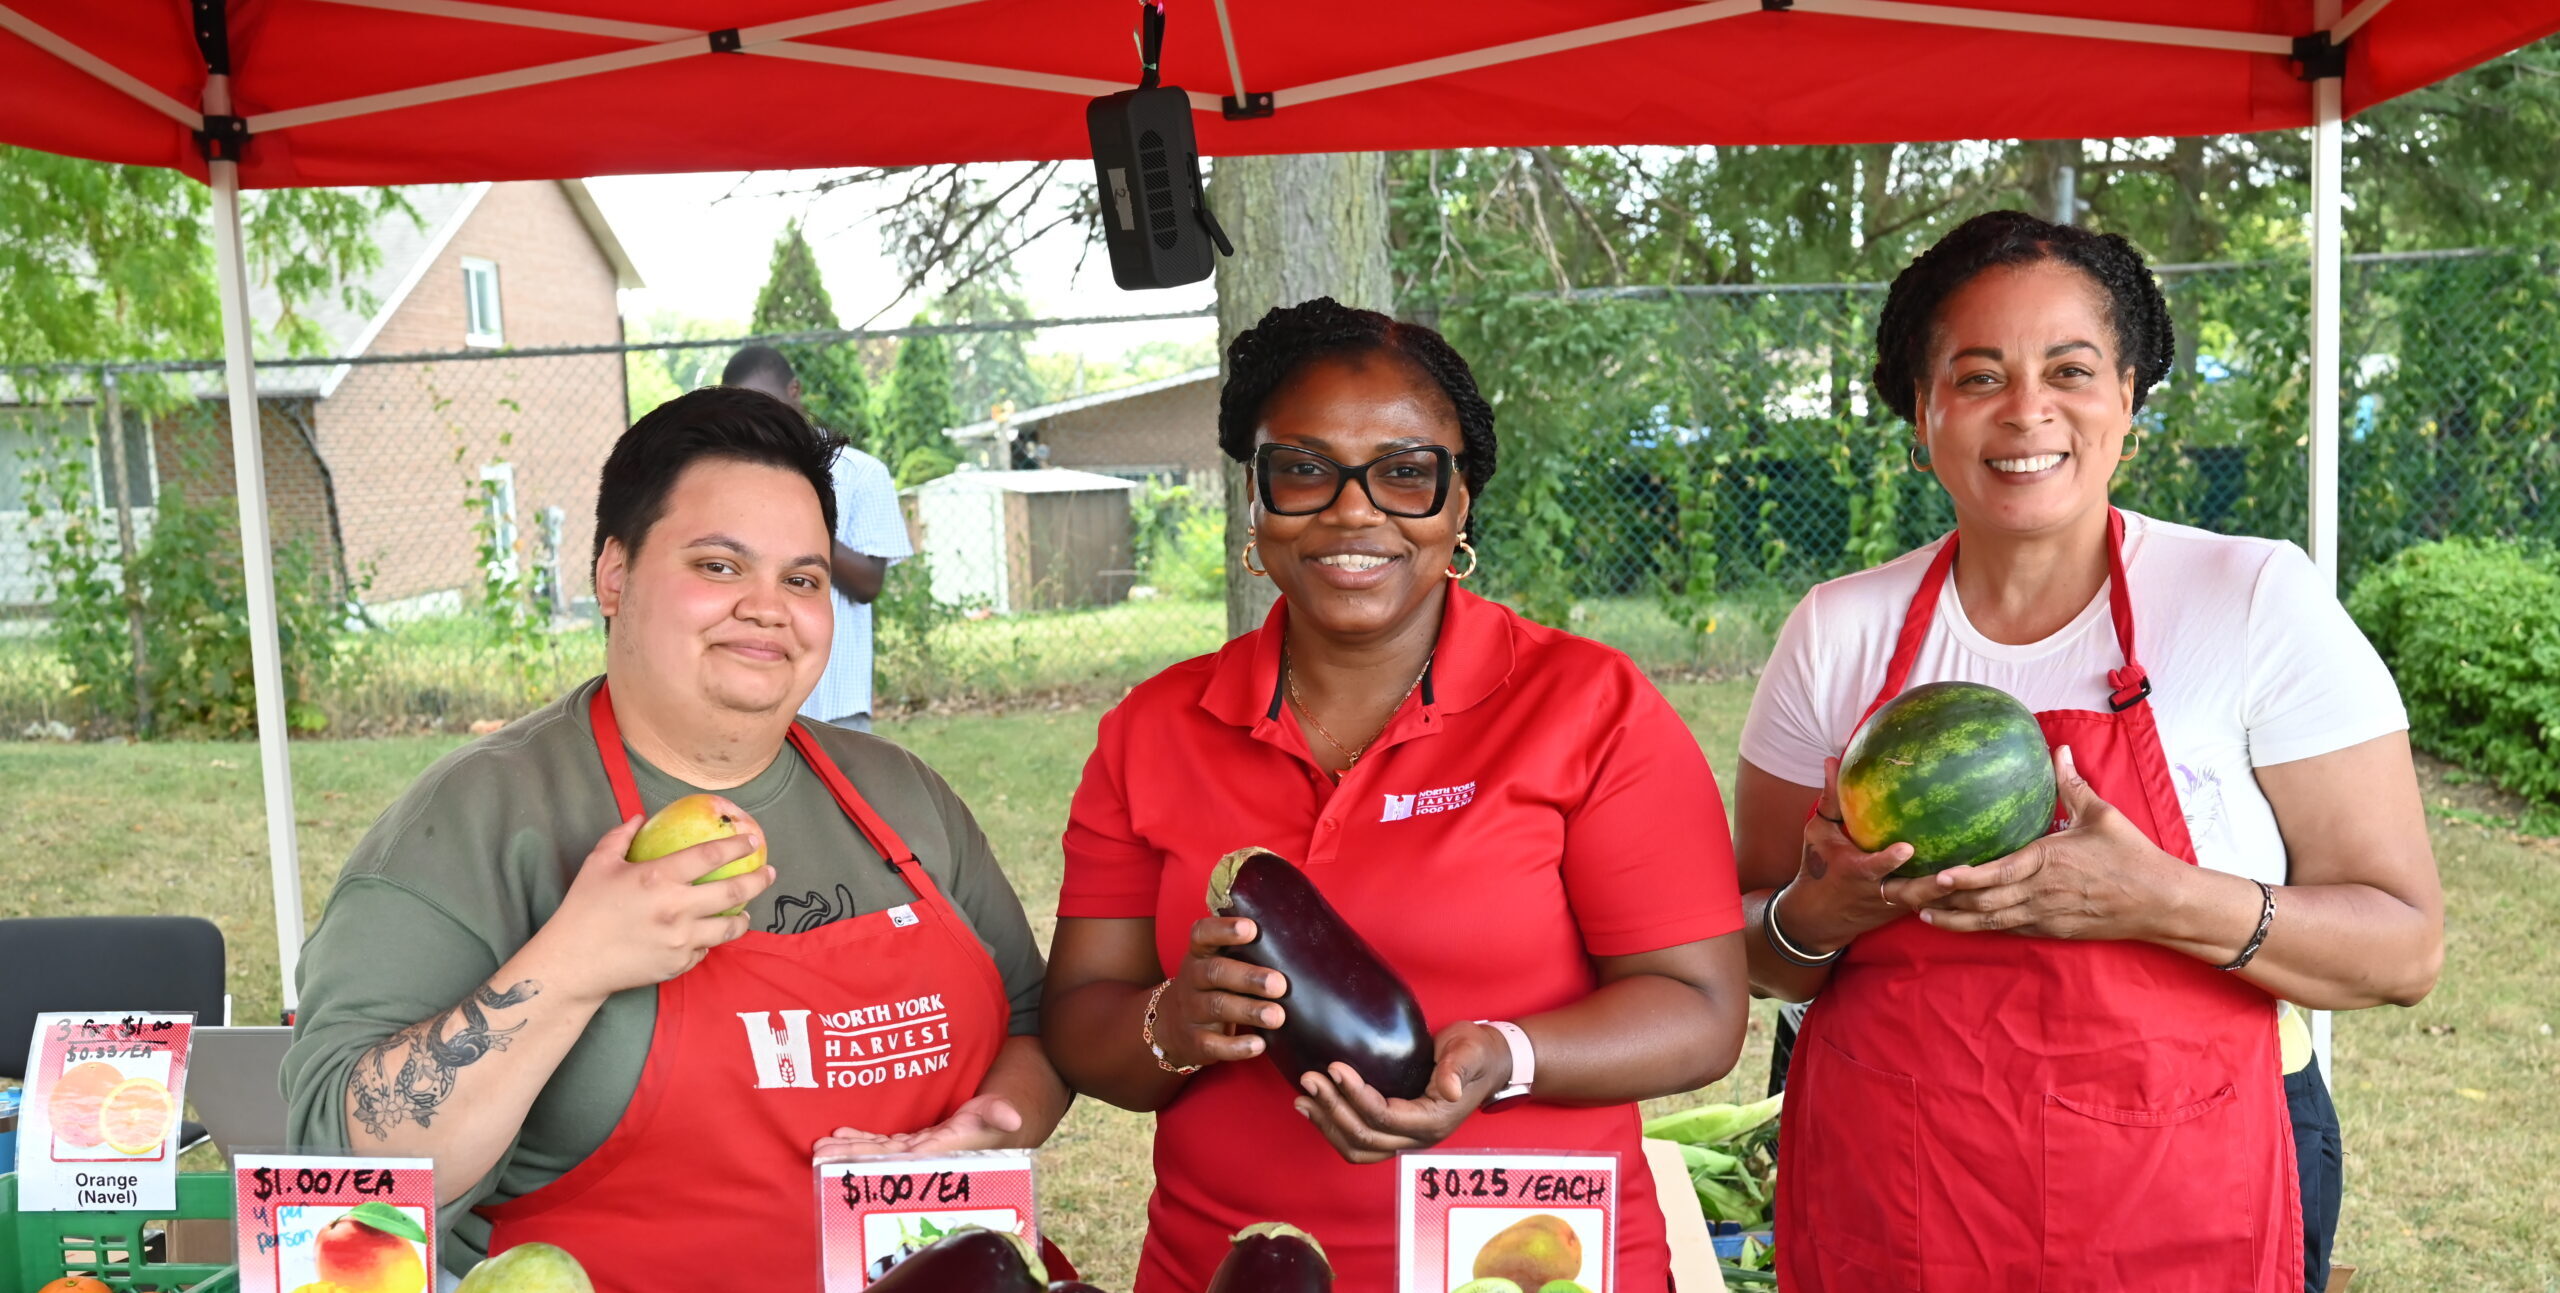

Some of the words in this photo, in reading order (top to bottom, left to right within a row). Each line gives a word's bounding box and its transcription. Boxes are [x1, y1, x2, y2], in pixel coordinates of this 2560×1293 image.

[1417, 790, 1475, 807] HARVEST
[1419, 787, 1450, 798] NORTH
[1452, 781, 1476, 793] YORK
[1416, 806, 1444, 816] FOOD
[819, 1003, 891, 1029] NORTH
[894, 993, 945, 1019] YORK
[56, 1018, 72, 1042] 3
[119, 1015, 173, 1038] $1.00
[824, 1022, 949, 1057] HARVEST
[66, 1045, 152, 1063] $0.33/EA
[826, 1066, 887, 1088] FOOD
[893, 1052, 950, 1080] BANK
[75, 1172, 138, 1190] Orange
[253, 1166, 395, 1202] $1.00/EA
[77, 1190, 138, 1207] (Navel)
[279, 1202, 310, 1226] per
[257, 1228, 313, 1255] person
